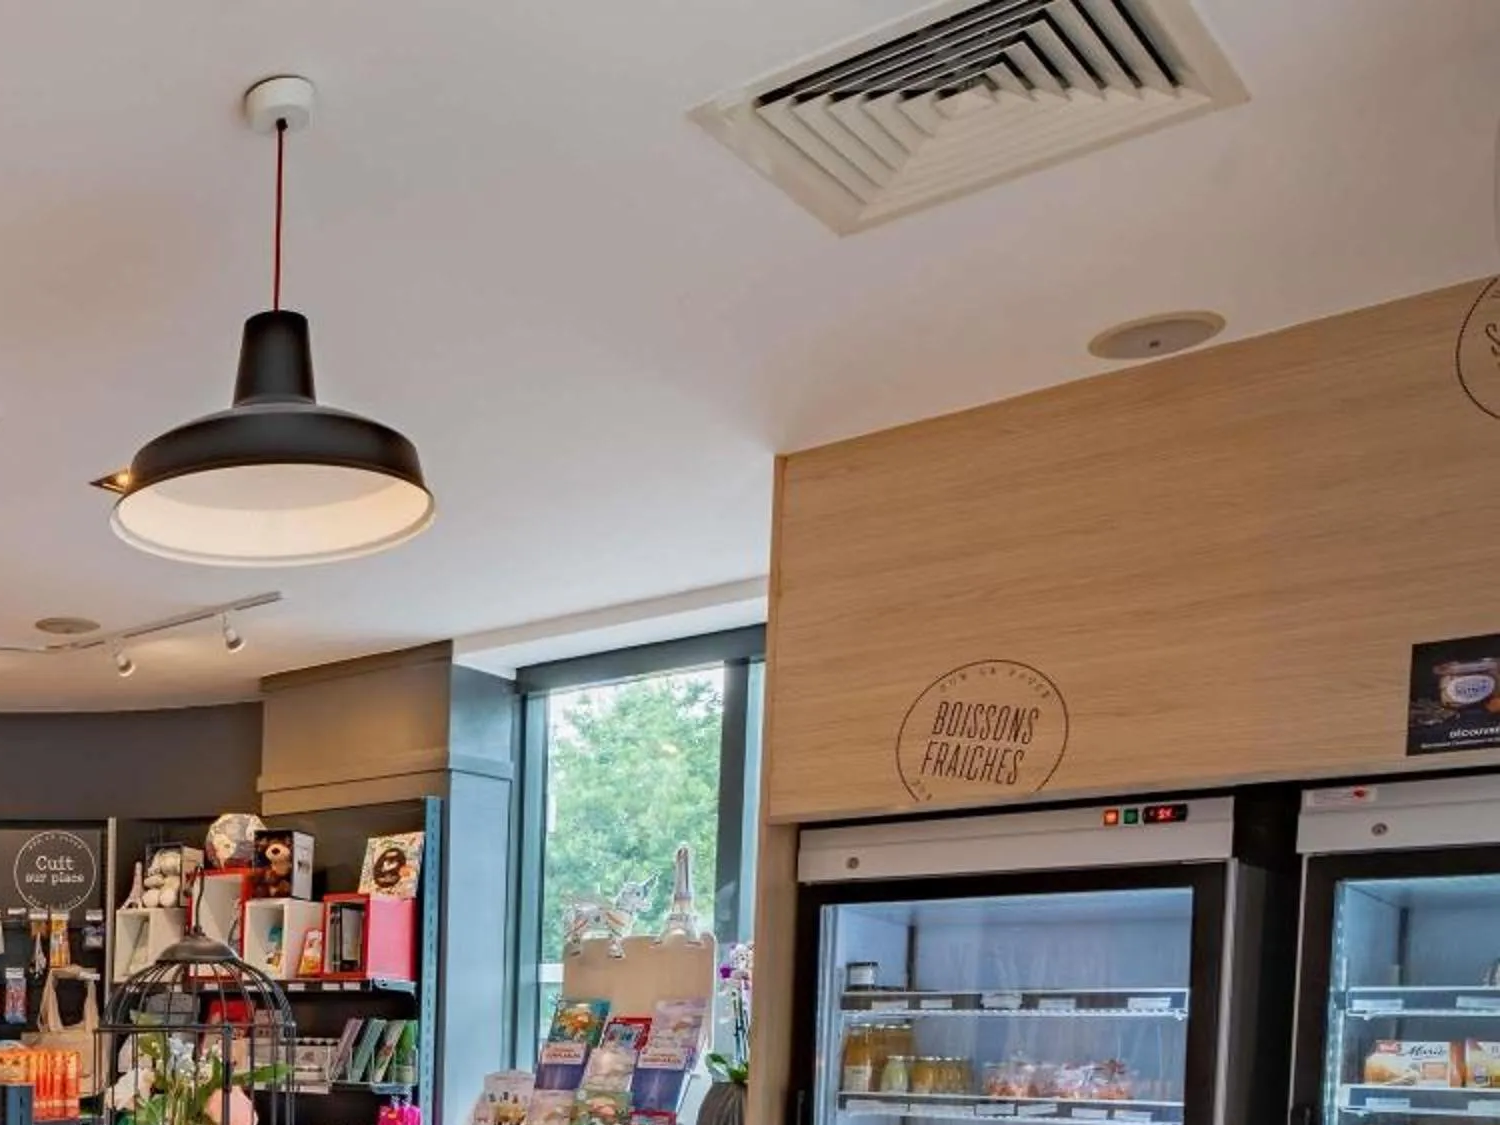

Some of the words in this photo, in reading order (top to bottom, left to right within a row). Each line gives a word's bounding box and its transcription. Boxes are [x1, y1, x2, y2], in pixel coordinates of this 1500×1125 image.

[931, 701, 1040, 745] BOISSONS
[920, 740, 1025, 785] FRAICHES
[35, 855, 74, 871] Cuit
